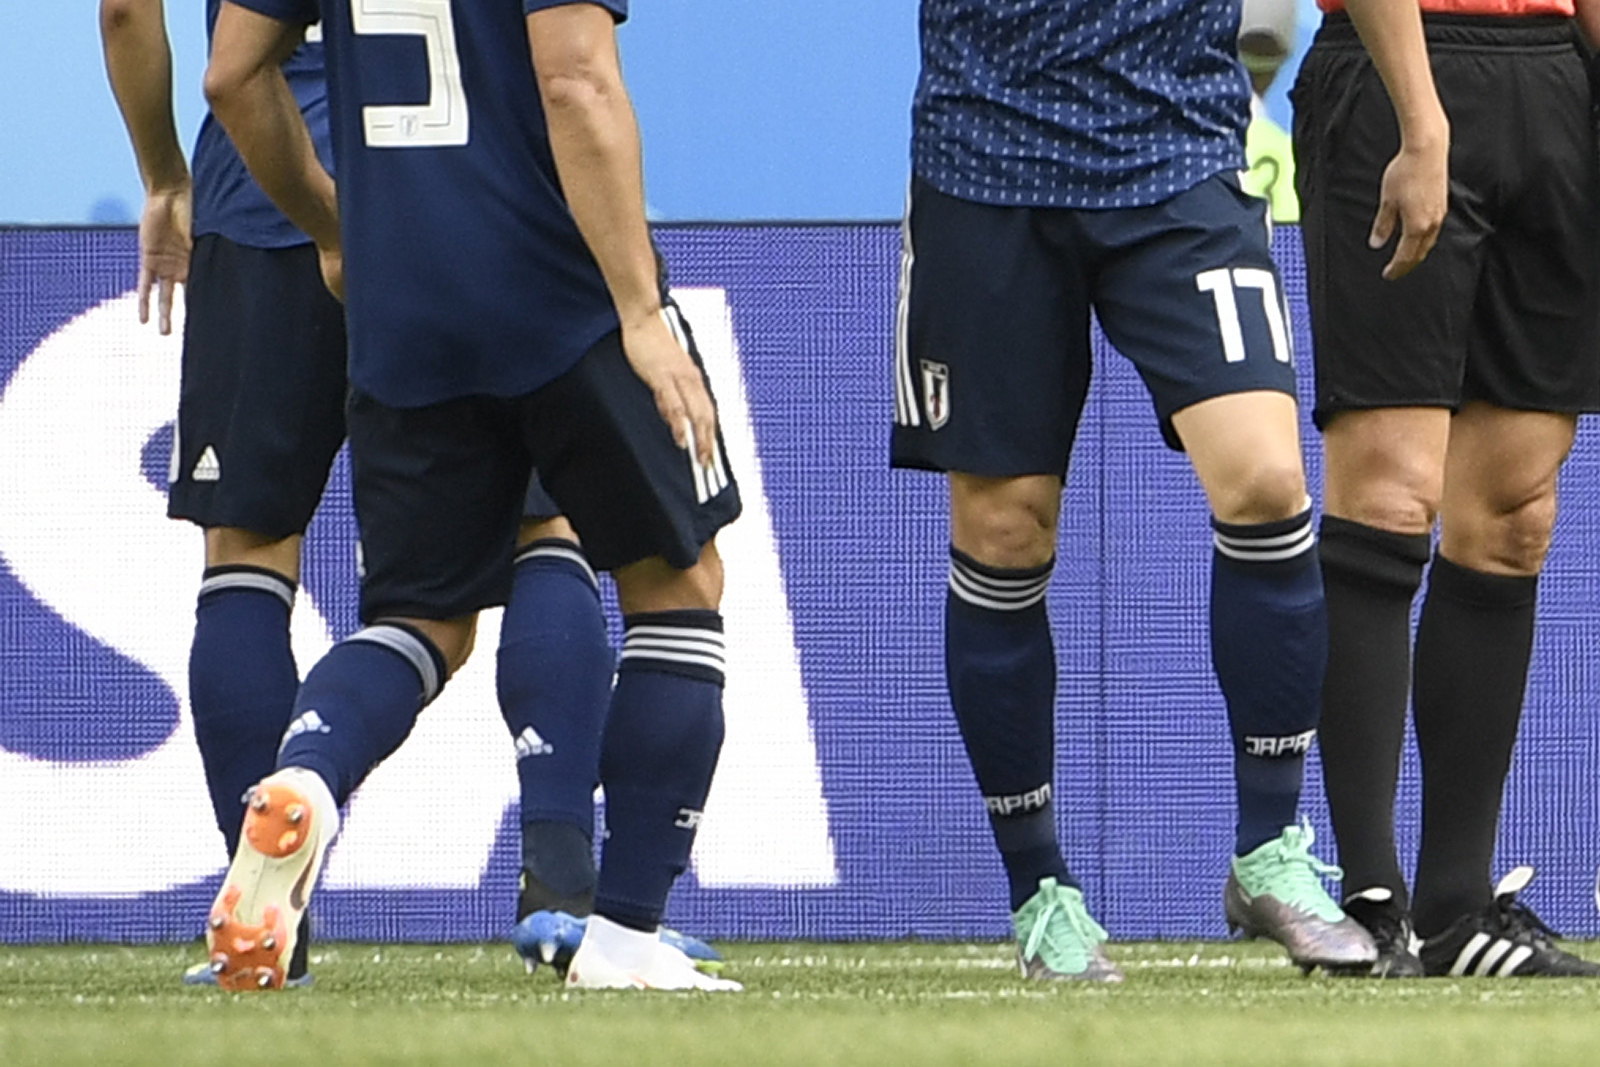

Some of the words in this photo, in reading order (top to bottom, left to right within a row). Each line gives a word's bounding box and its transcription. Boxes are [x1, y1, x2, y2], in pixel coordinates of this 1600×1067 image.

[1196, 267, 1290, 363] 17
[1245, 729, 1317, 757] JAPA
[985, 783, 1051, 815] APAN
